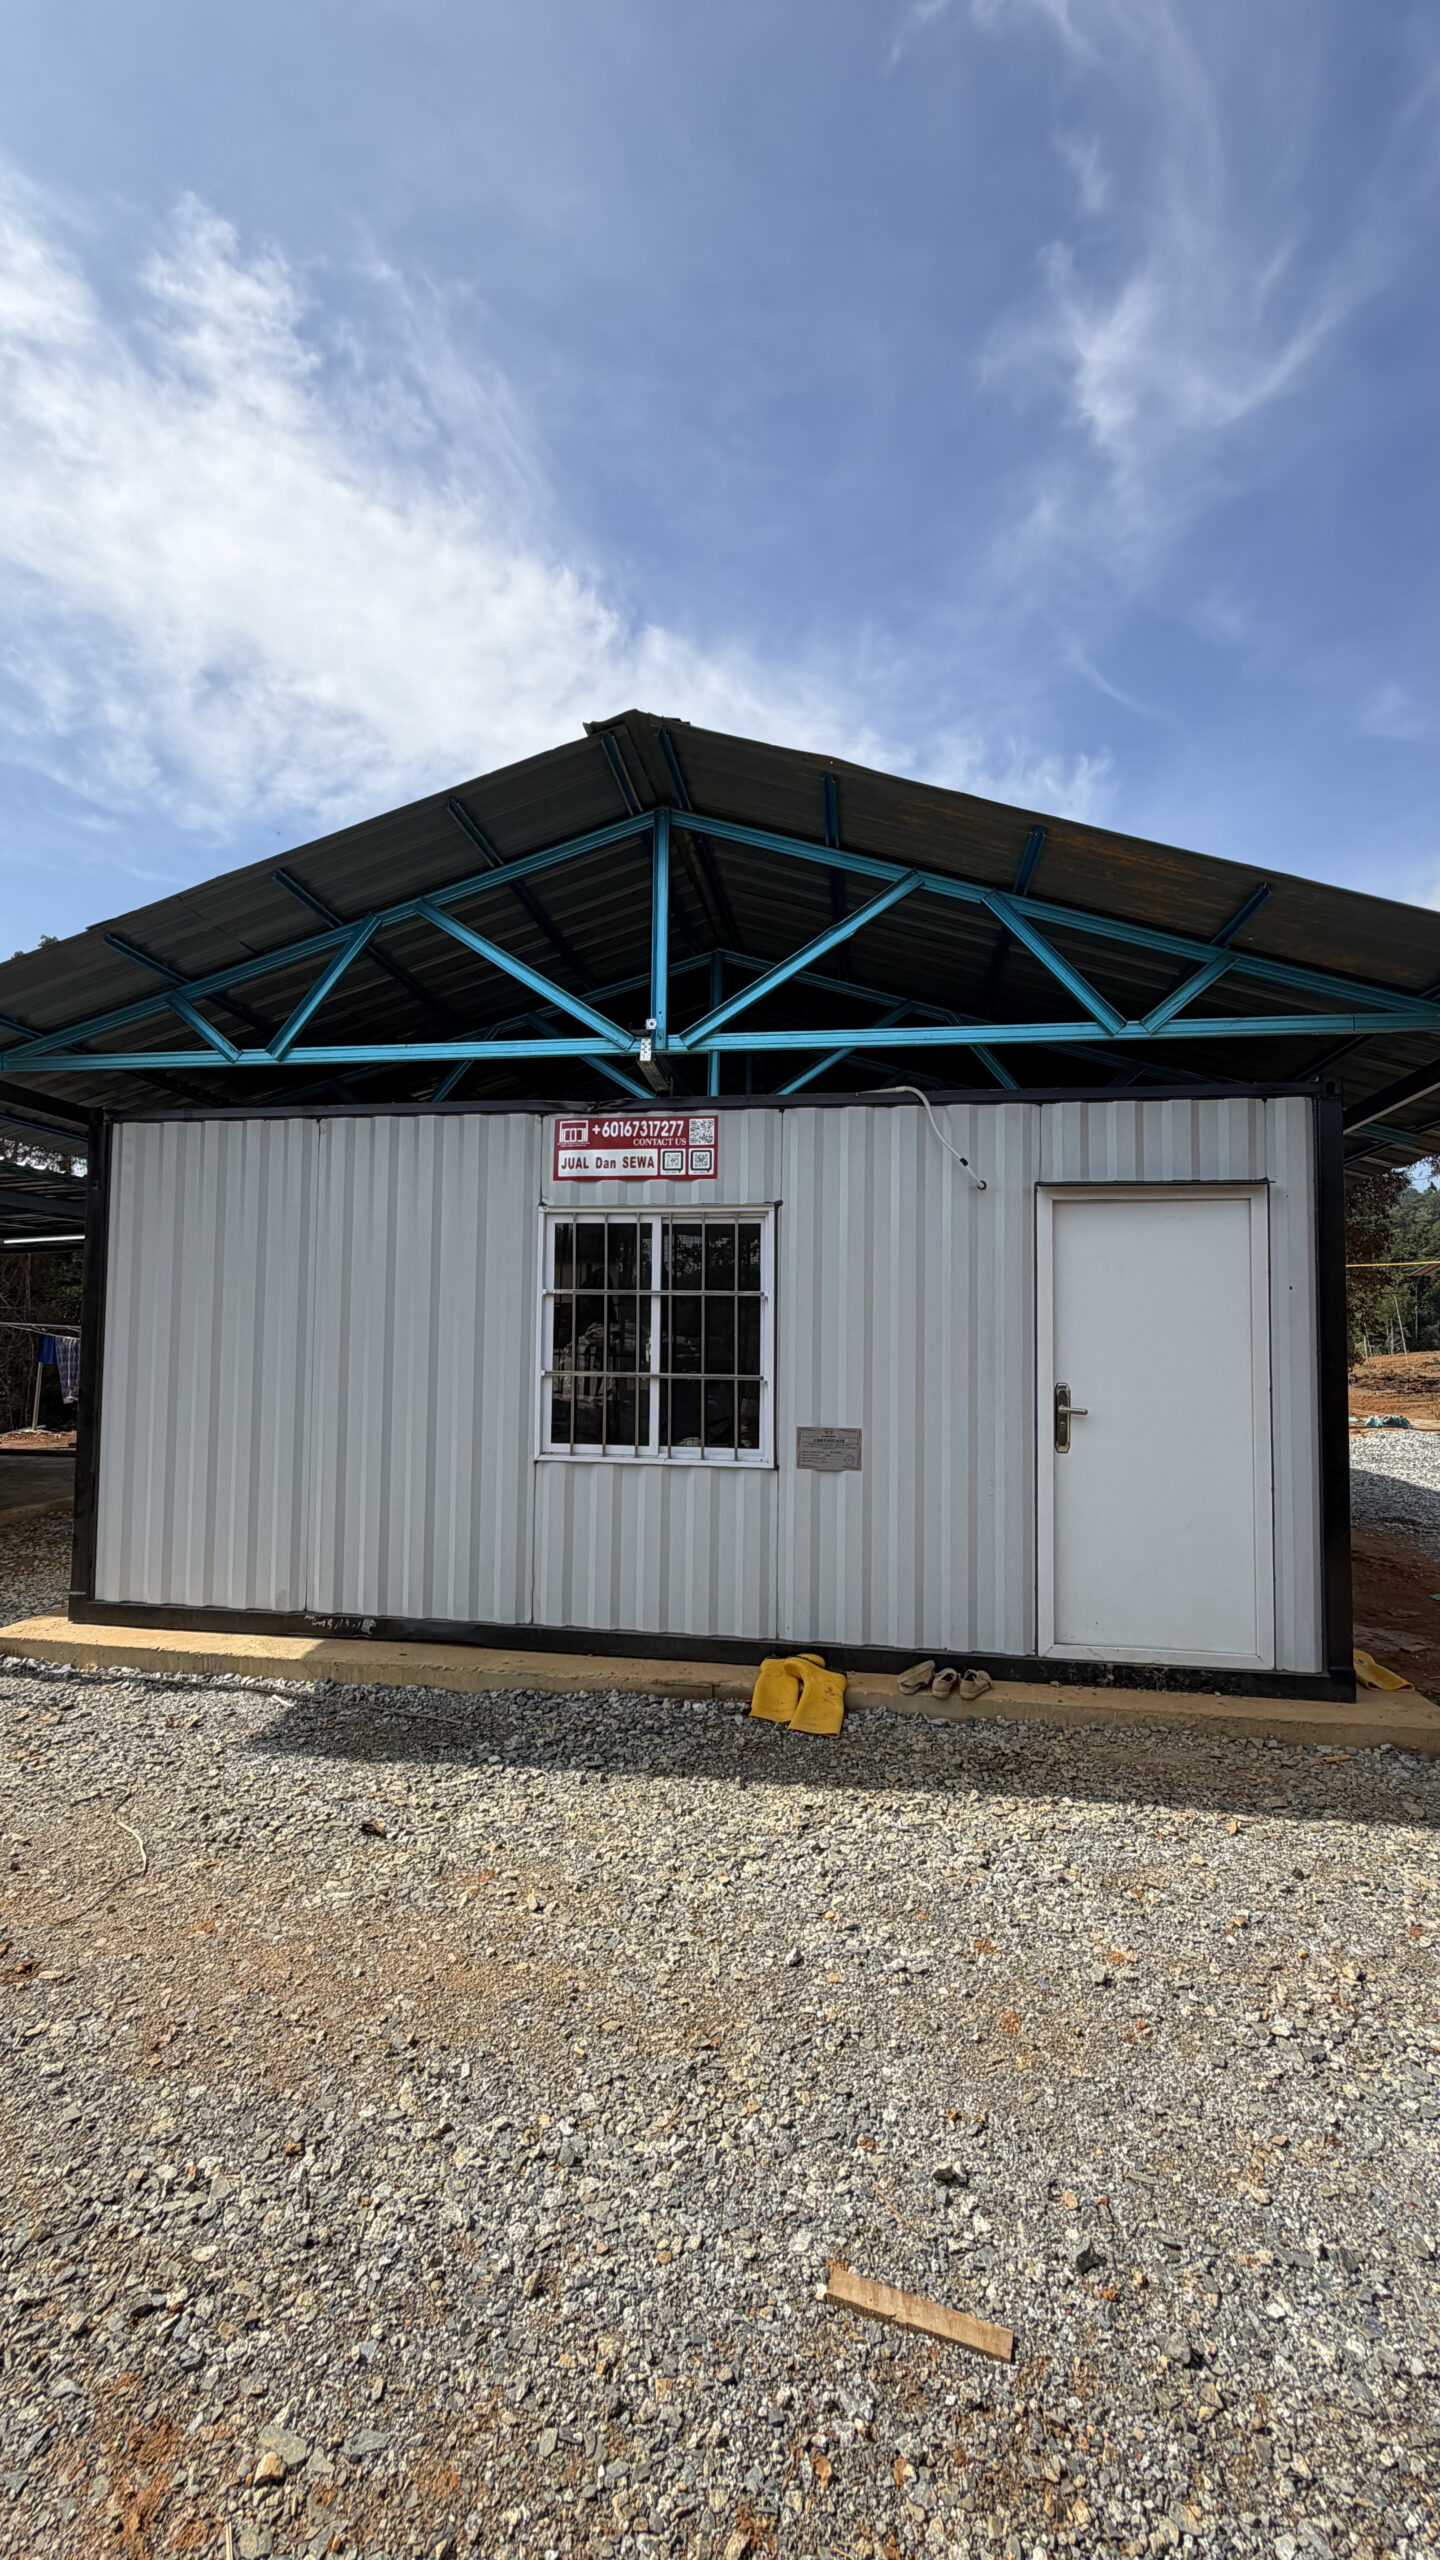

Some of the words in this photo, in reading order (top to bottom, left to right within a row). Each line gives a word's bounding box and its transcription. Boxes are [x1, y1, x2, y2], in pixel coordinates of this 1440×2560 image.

[592, 1121, 684, 1137] +60167317277
[633, 1138, 673, 1146] CONTACT
[675, 1138, 687, 1146] US
[561, 1157, 589, 1169] JUAL
[595, 1157, 616, 1169] Dan
[622, 1156, 655, 1168] SEWA
